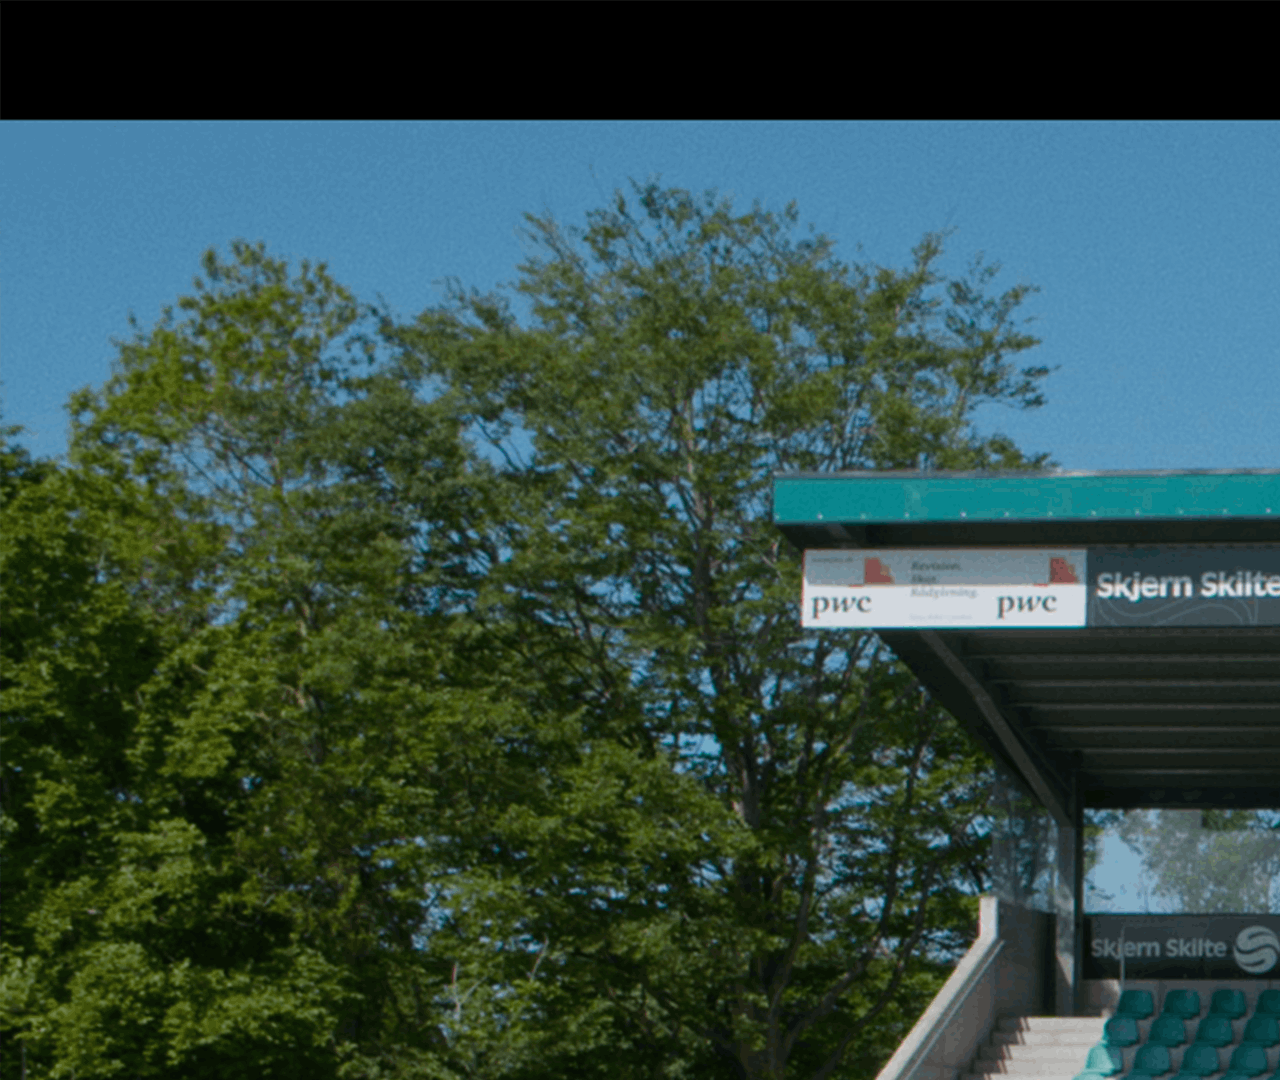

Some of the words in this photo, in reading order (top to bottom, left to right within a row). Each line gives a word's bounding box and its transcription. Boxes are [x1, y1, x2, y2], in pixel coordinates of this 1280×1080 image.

[1096, 571, 1193, 604] Skjern
[811, 595, 872, 620] pwc
[998, 594, 1058, 619] pwc
[1091, 938, 1160, 961] Skjern
[1166, 937, 1227, 958] Skilte
